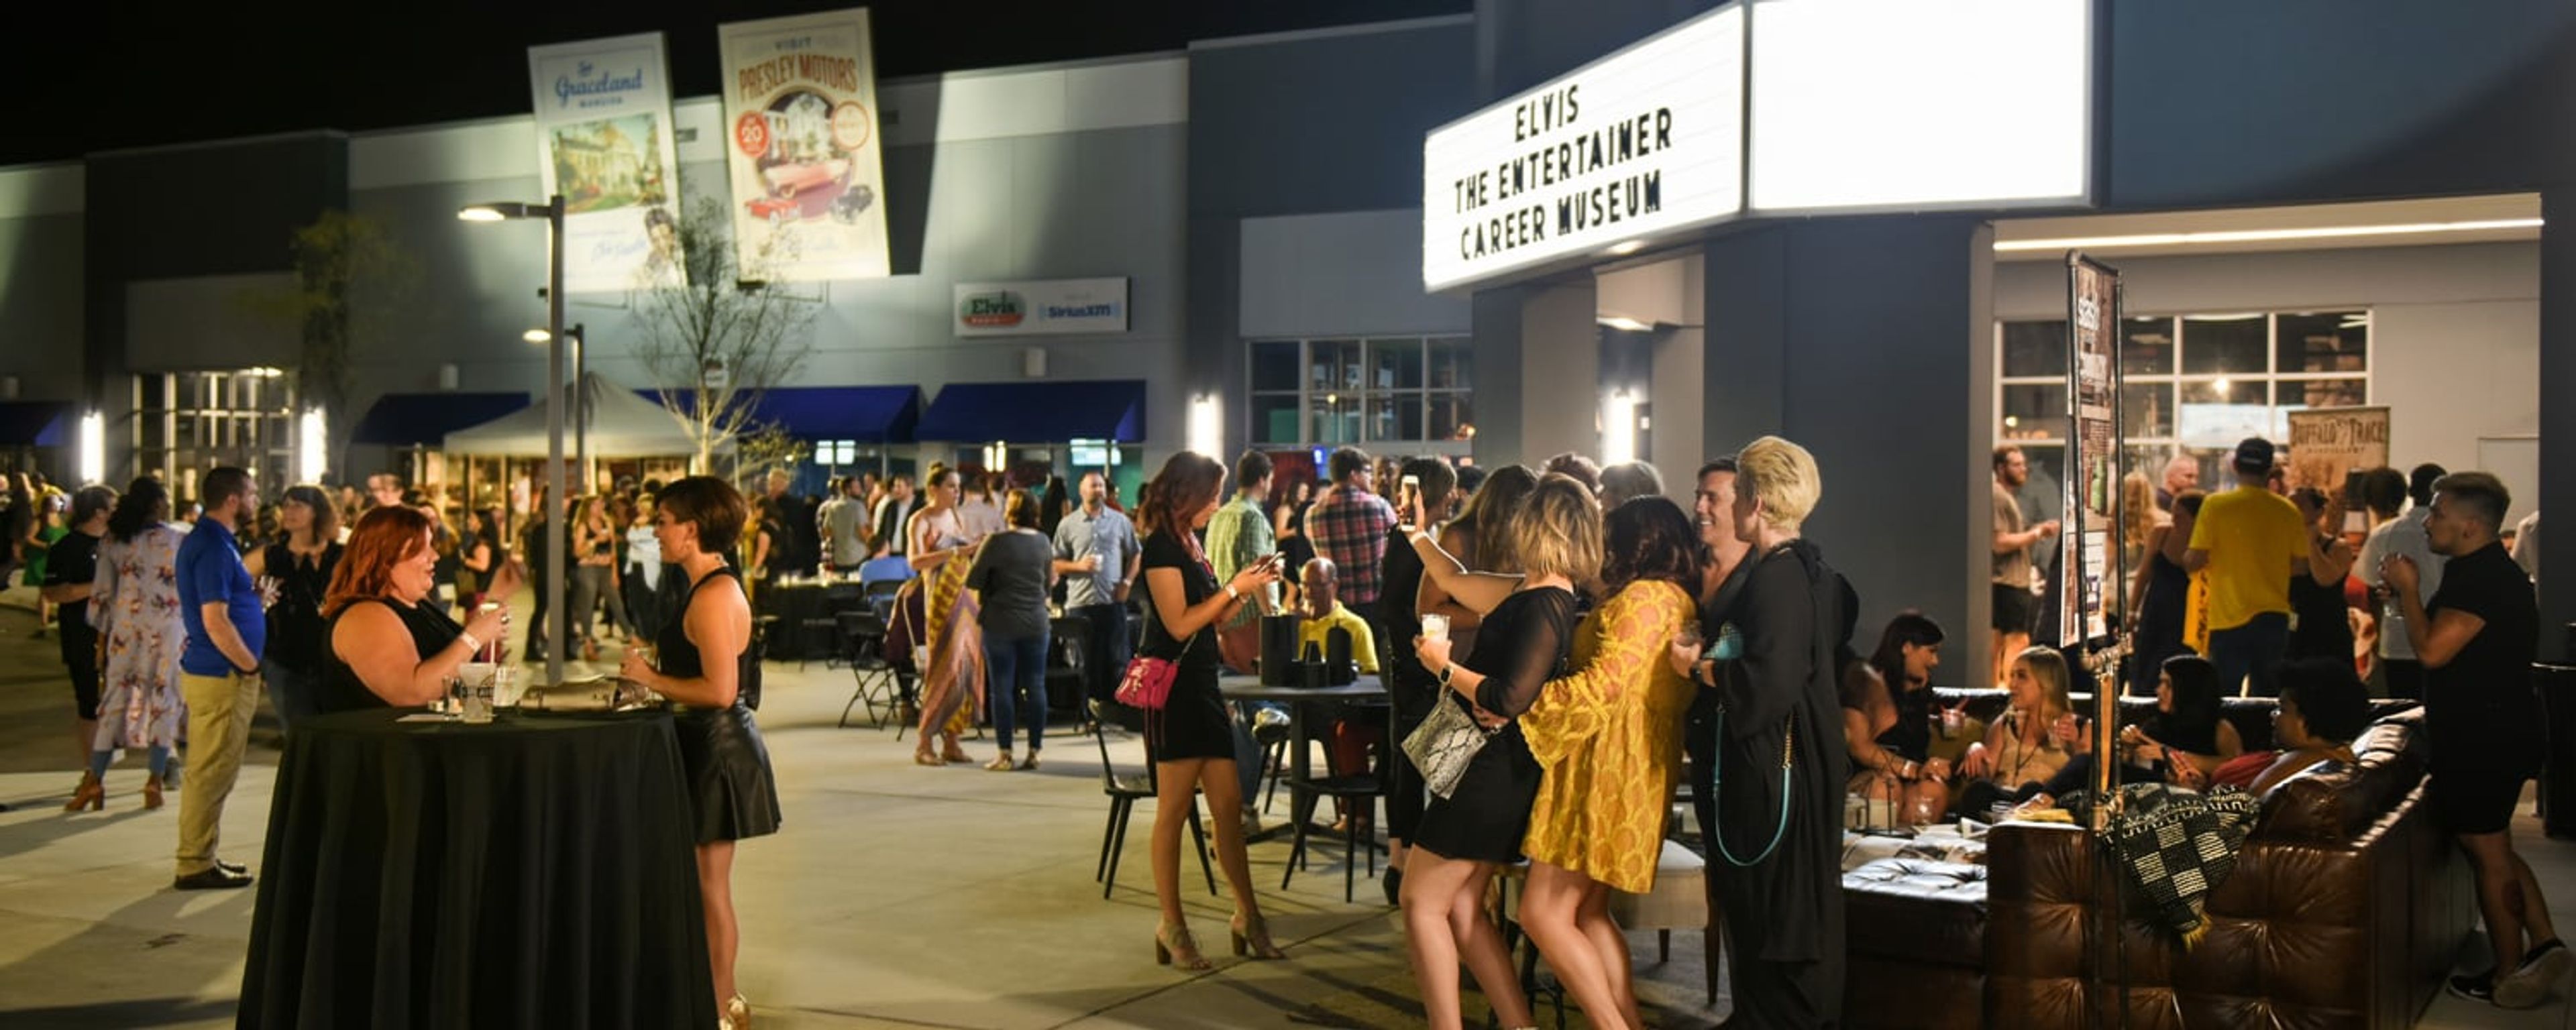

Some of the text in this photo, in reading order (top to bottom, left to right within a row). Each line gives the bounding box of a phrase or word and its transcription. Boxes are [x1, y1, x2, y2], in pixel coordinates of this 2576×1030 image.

[555, 68, 642, 109] Graceland
[739, 54, 858, 103] PRESLEY MOTORS
[1515, 84, 1579, 143] ELVIS
[1454, 107, 1672, 214] THE ENTERTAINER
[1460, 169, 1662, 261] CAREER MUSEUM
[972, 290, 1016, 314] Elvis
[2291, 417, 2385, 447] BUFFALO TRACE
